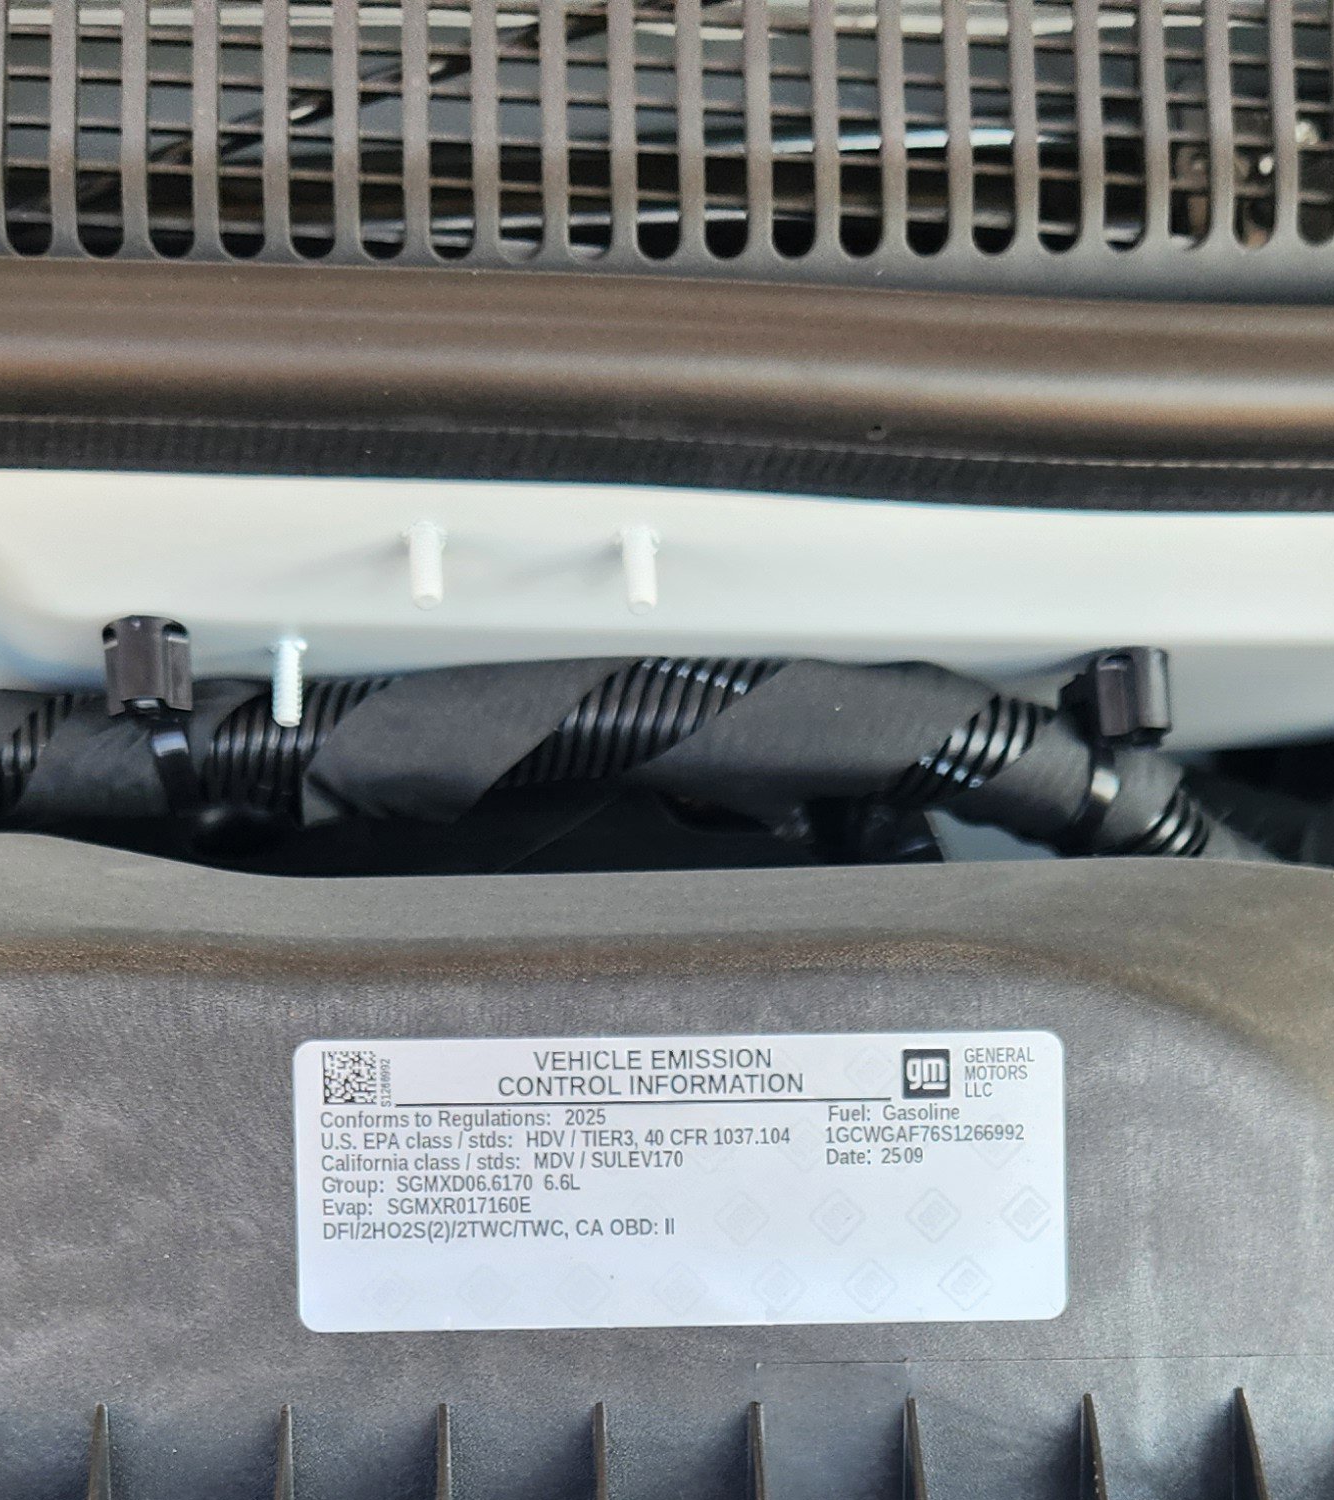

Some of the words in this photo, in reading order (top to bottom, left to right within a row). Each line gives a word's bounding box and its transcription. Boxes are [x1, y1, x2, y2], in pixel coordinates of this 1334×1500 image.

[534, 1050, 642, 1072] VEHICLE
[652, 1048, 772, 1070] EMISSION
[964, 1047, 1035, 1063] GENERAL
[906, 1057, 948, 1091] gm
[964, 1065, 1028, 1081] MOTORS
[498, 1075, 622, 1097] CONTROL
[629, 1073, 804, 1095] INFORMATION
[965, 1082, 993, 1098] LLC
[320, 1112, 409, 1128] Conforms
[415, 1112, 432, 1127] to
[438, 1109, 551, 1131] Regulations:
[565, 1109, 606, 1126] 2025
[828, 1104, 871, 1122] Fuel:
[882, 1103, 960, 1121] Gasoline
[321, 1133, 357, 1150] U.S.
[363, 1133, 400, 1149] EPA
[406, 1131, 453, 1149] class
[457, 1131, 463, 1149] /
[468, 1131, 513, 1148] stds:
[526, 1130, 565, 1148] HDV
[570, 1129, 576, 1148] /
[581, 1129, 639, 1149] TIER3,
[645, 1128, 664, 1146] 40
[670, 1128, 708, 1146] CFR
[714, 1127, 790, 1145] 1037.104
[825, 1124, 1025, 1144] 1GCWGAF76S1266992
[321, 1154, 408, 1172] California
[414, 1153, 460, 1171] class
[465, 1153, 471, 1171] /
[476, 1152, 520, 1170] stds:
[534, 1151, 574, 1169] MDV
[579, 1151, 585, 1169] /
[591, 1150, 684, 1168] SULEV170
[826, 1148, 872, 1165] Date:
[880, 1147, 924, 1164] 2509
[322, 1177, 384, 1198] Group:
[396, 1174, 533, 1193] SGMXD06.6170
[544, 1174, 581, 1191] 6.6L
[322, 1199, 373, 1220] Evap:
[387, 1197, 532, 1215] SGMXR017160E
[323, 1219, 570, 1243] DFI/2HO2S(2)/2TWC/TWC,
[576, 1219, 604, 1237] CA
[610, 1218, 659, 1236] OBD:
